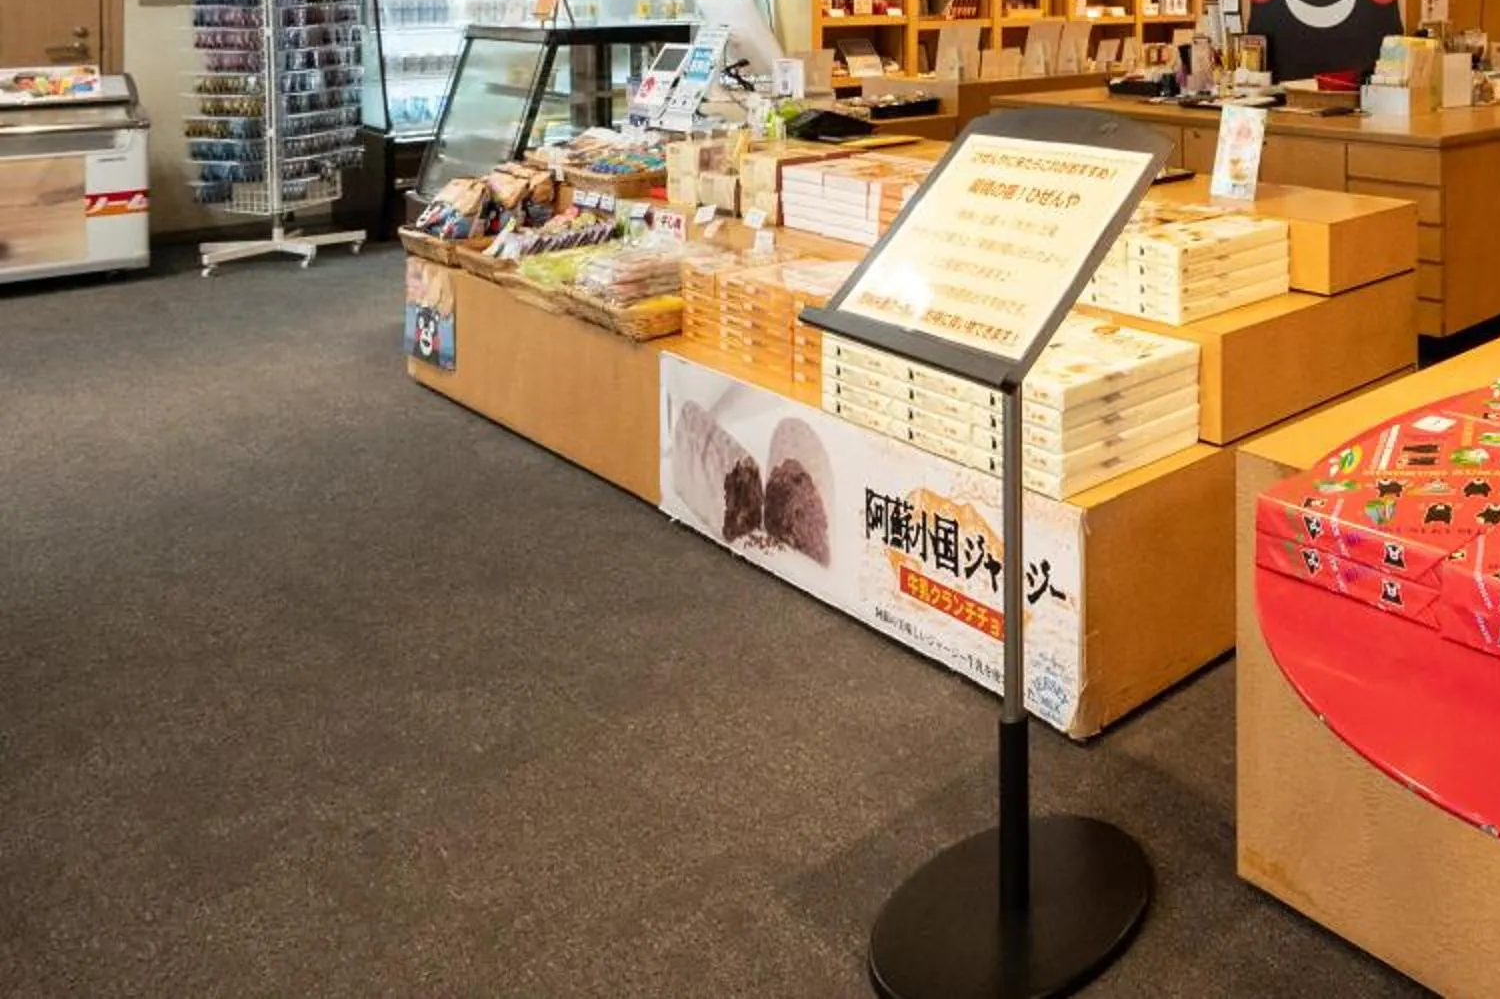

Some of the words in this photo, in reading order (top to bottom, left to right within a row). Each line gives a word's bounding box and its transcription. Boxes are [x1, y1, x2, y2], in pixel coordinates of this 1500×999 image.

[865, 486, 1066, 605] 阿蘇小国ジャジー
[907, 573, 1003, 639] 牛乳クランチチョ
